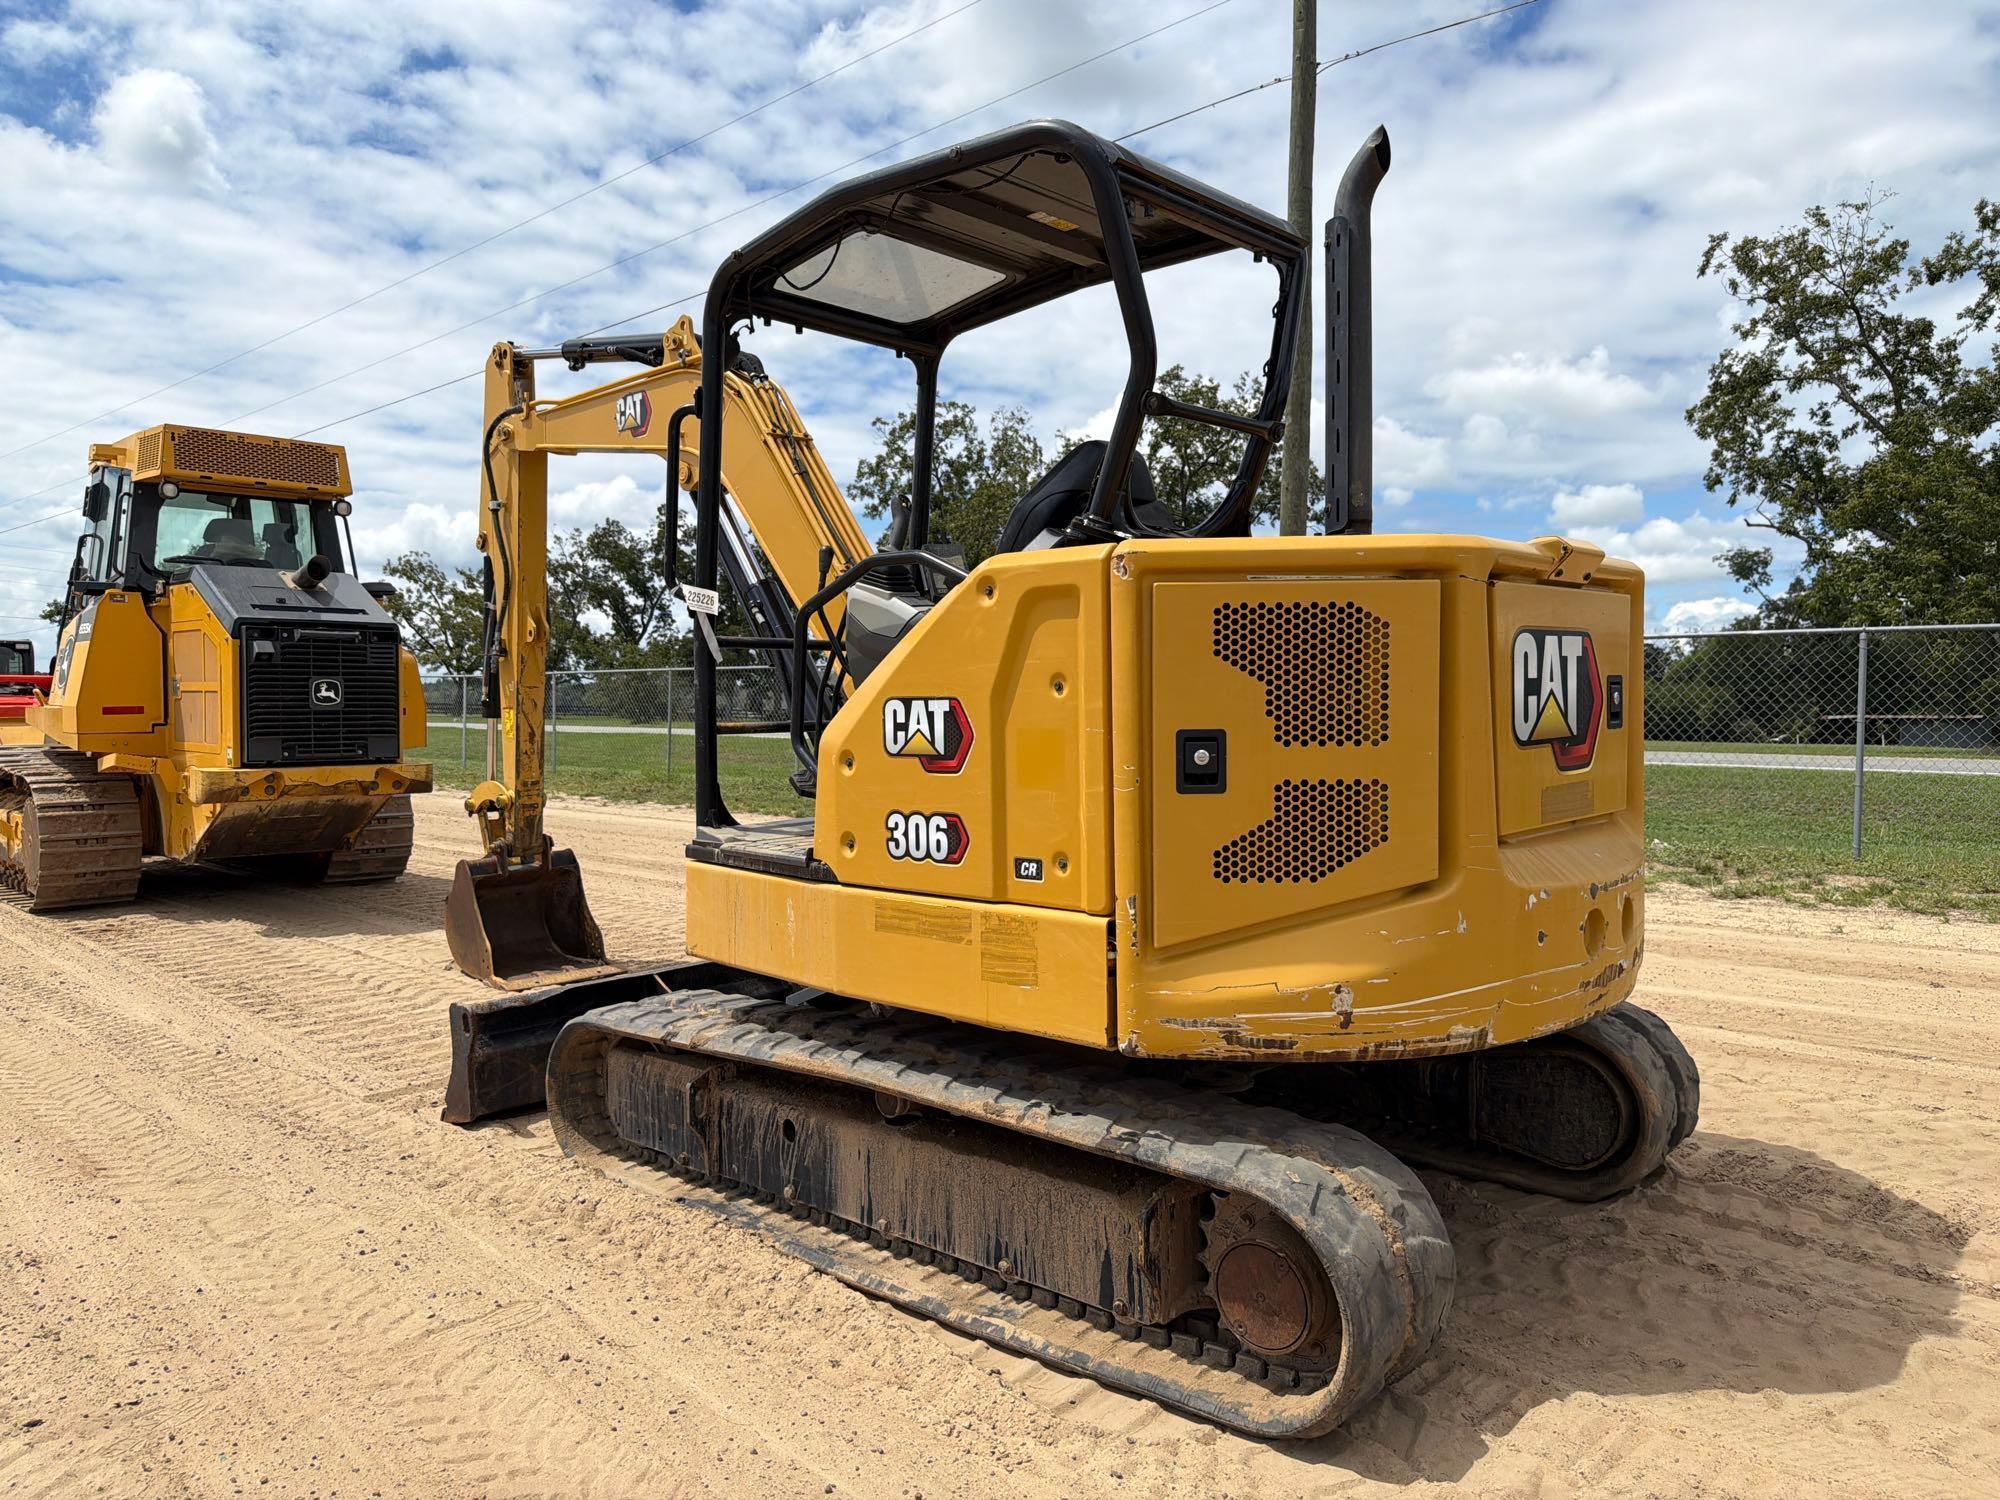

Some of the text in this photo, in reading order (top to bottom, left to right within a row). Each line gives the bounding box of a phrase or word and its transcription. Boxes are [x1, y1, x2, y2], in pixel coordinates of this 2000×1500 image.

[616, 392, 643, 431] CAT
[687, 590, 715, 607] 225226
[1513, 632, 1583, 742] CAT
[884, 699, 950, 755] CAT
[887, 813, 948, 861] 306
[1020, 861, 1037, 877] CR
